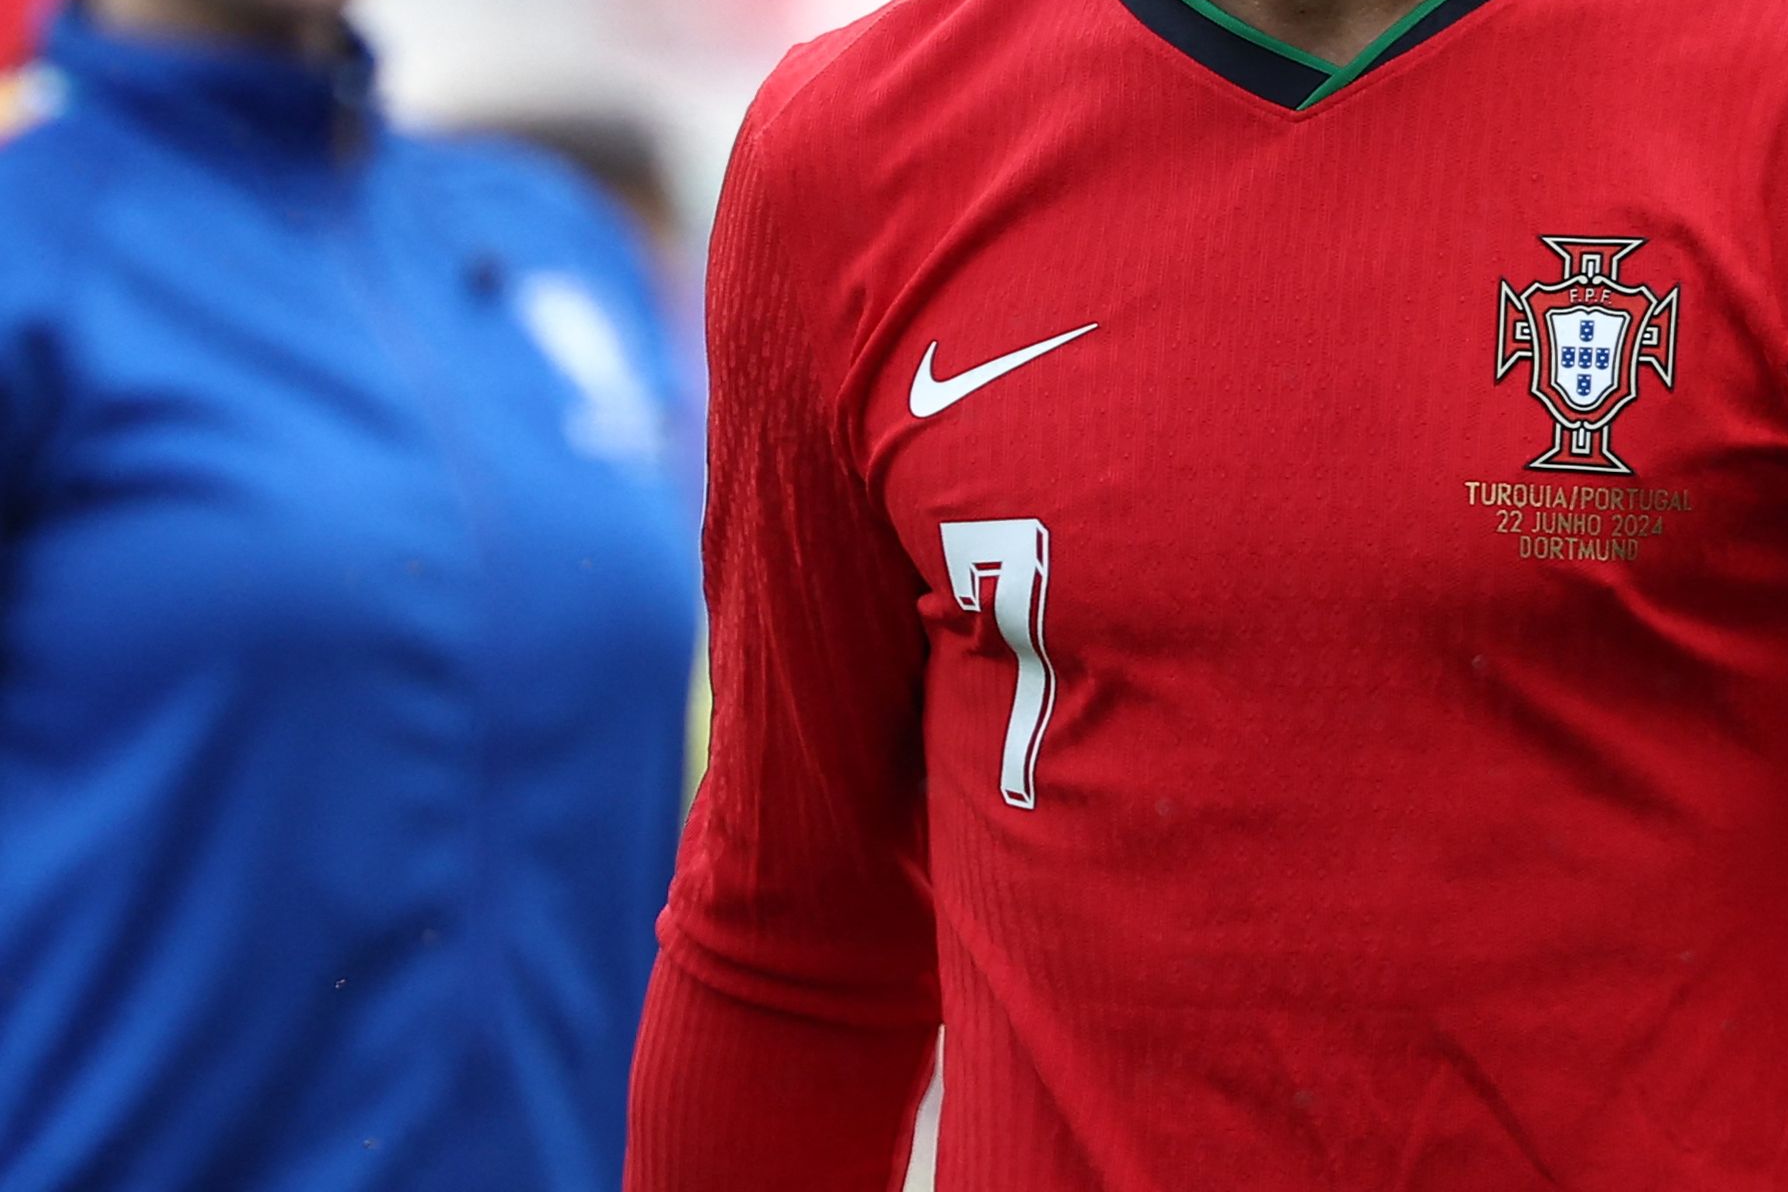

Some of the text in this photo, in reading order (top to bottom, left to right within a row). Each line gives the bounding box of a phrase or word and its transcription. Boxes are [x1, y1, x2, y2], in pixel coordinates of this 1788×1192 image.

[1465, 481, 1692, 511] TURQUIA/PORTUGAL
[1496, 510, 1664, 537] 22 JUNHO 2024
[1519, 535, 1639, 561] DORTMUND
[940, 518, 1056, 810] 7
